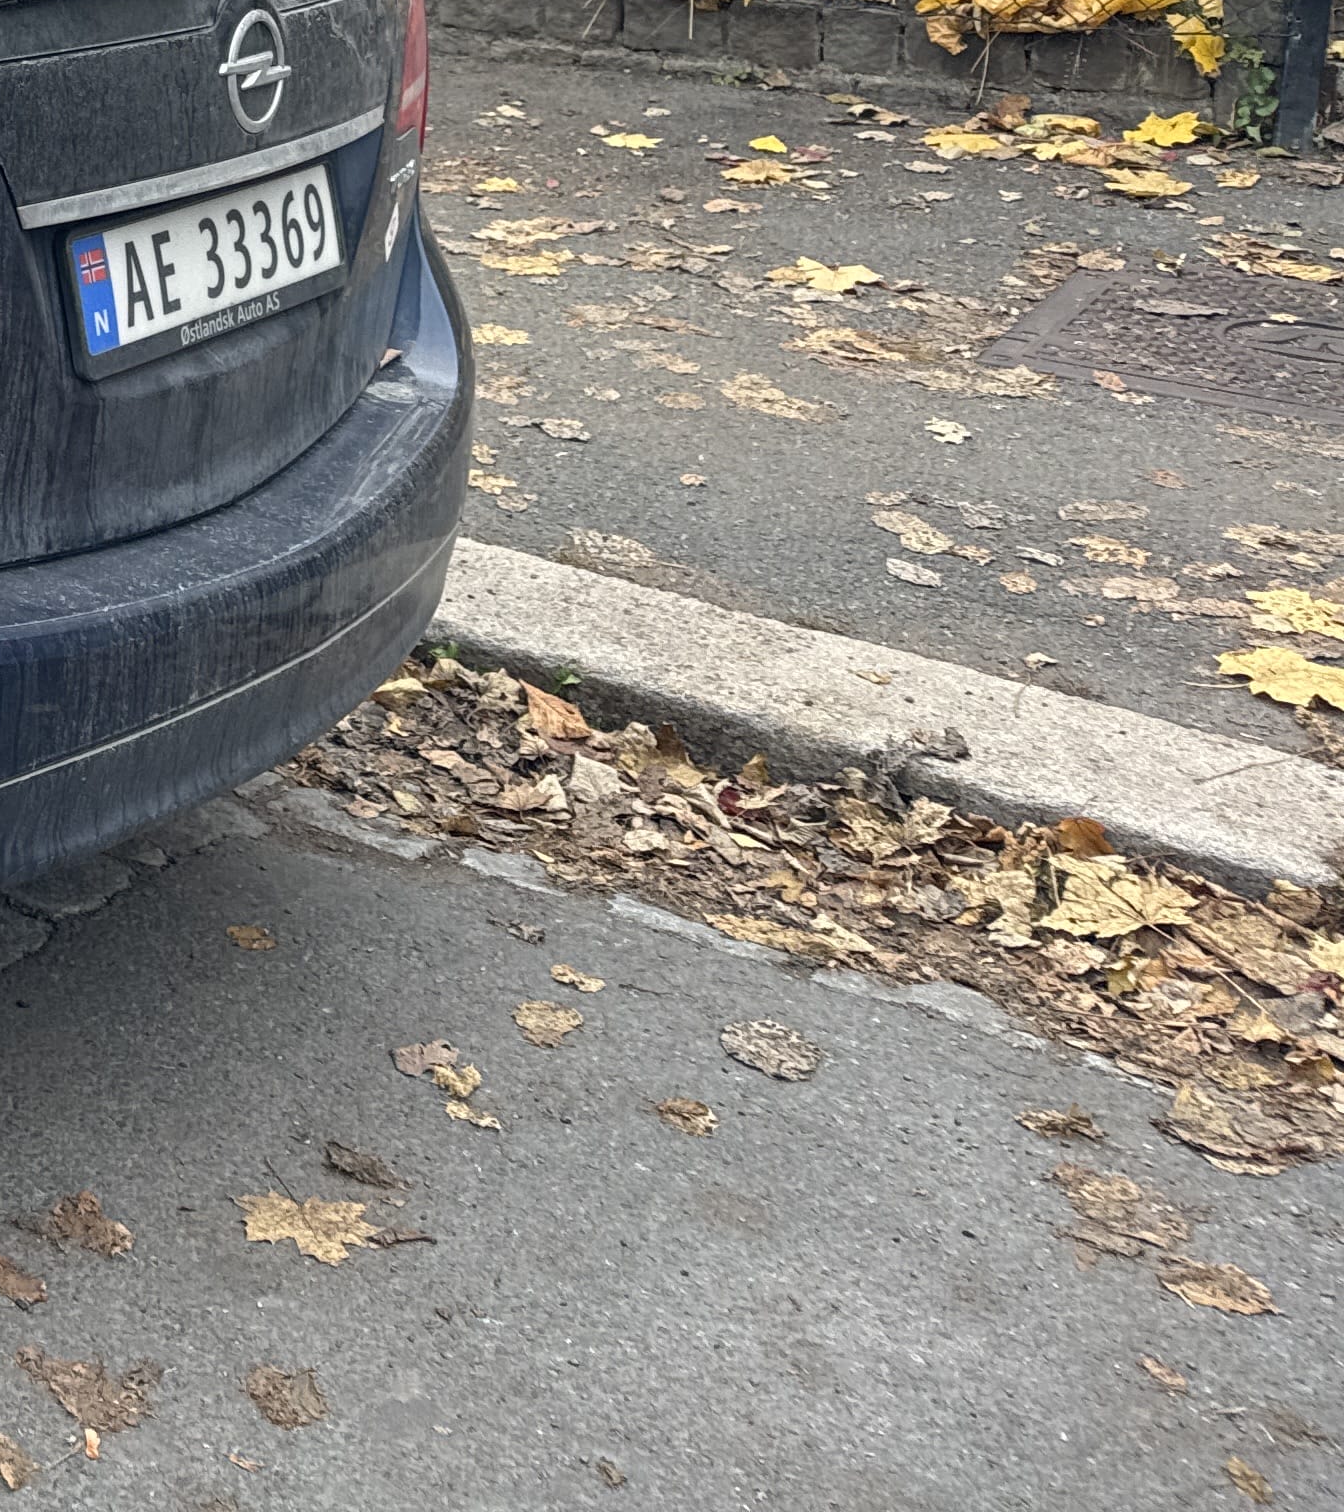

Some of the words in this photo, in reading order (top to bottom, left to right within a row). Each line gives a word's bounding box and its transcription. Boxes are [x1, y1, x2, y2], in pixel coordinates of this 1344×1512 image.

[124, 229, 182, 328] AE
[198, 183, 326, 299] 33369
[93, 308, 110, 337] N
[180, 310, 235, 347] Østlandsk
[237, 301, 264, 325] Auto
[266, 291, 281, 312] AS
